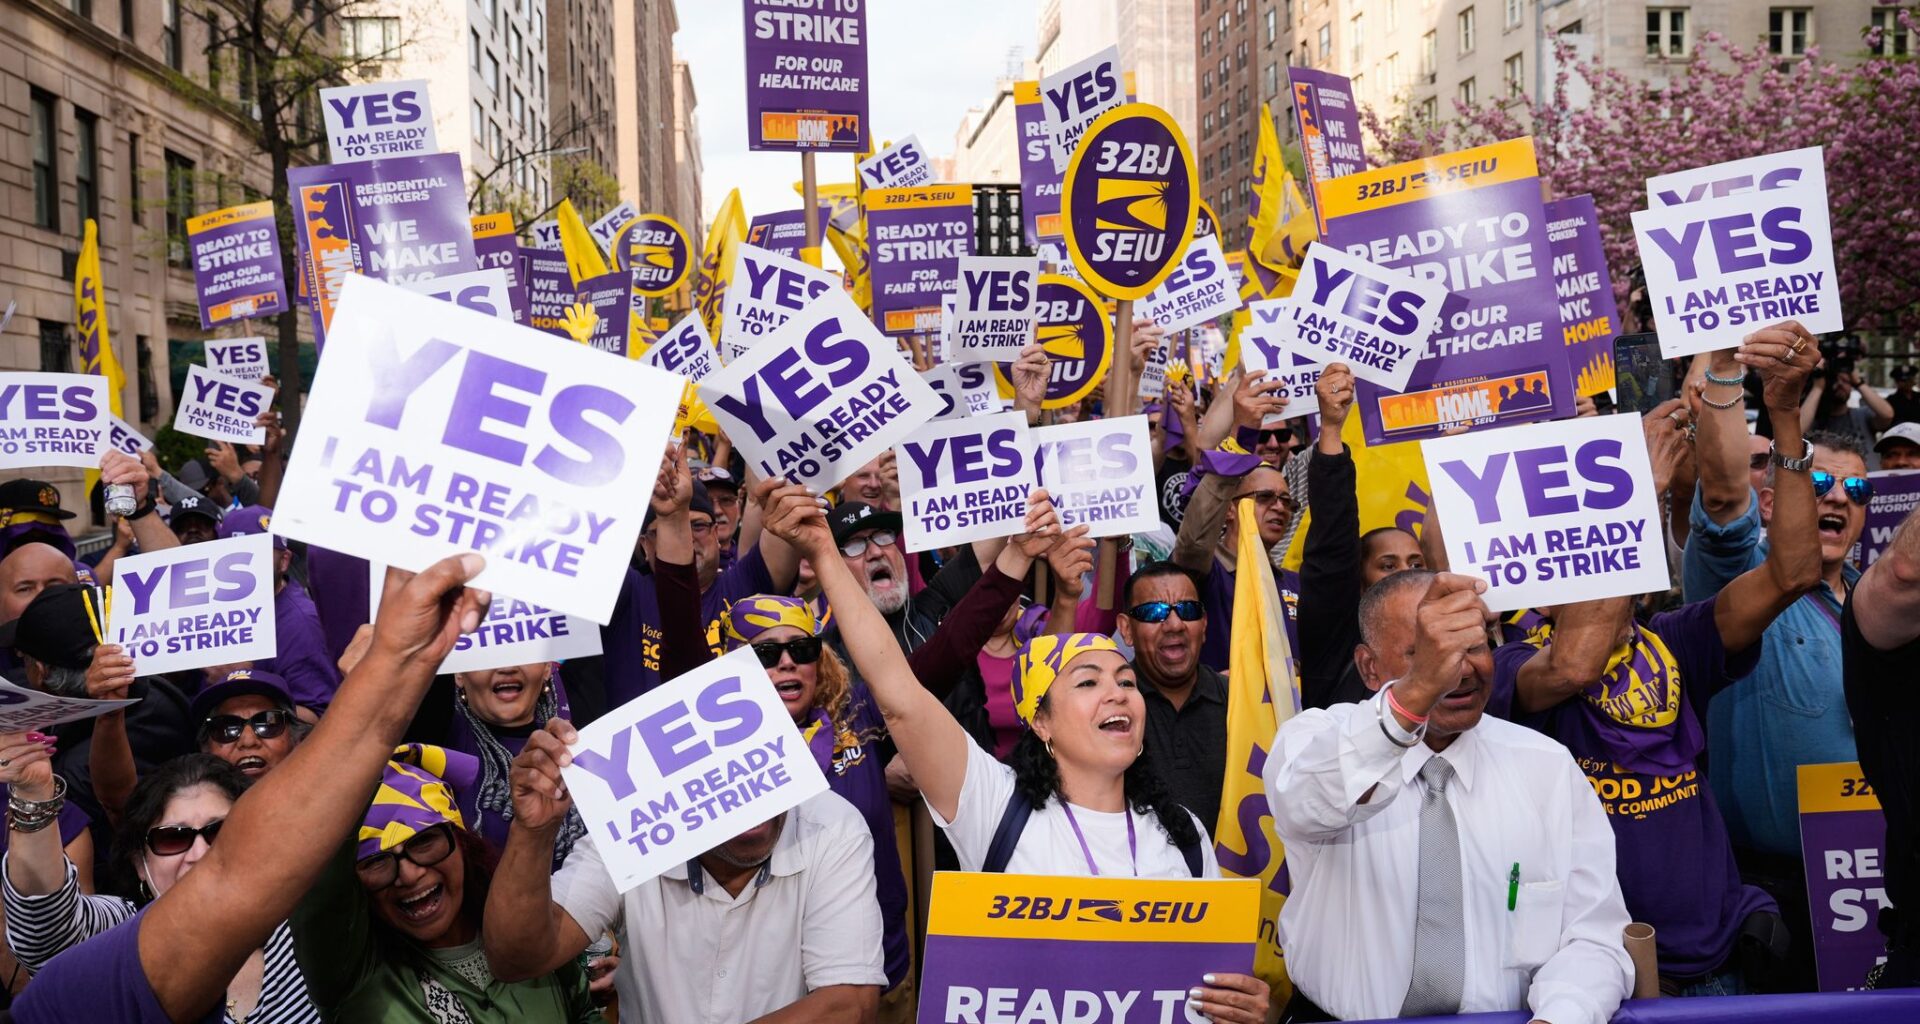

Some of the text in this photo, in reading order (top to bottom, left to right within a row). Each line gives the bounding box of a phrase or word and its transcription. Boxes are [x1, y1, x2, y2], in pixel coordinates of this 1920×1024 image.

[755, 11, 859, 45] STRIKE
[775, 56, 842, 73] FOR OUR
[759, 74, 859, 92] HEALTHCARE
[1047, 62, 1116, 123] YES
[328, 91, 422, 129] YES
[337, 128, 427, 146] I AM READY
[797, 120, 828, 141] HOME
[1057, 134, 1061, 145] I
[1064, 123, 1084, 142] AM
[1325, 120, 1346, 138] WE
[344, 140, 424, 158] TO STRIKE
[1096, 141, 1175, 175] 32BJ
[1329, 142, 1360, 161] MAKE
[865, 144, 920, 185] YES
[899, 164, 928, 186] READY
[356, 178, 446, 196] RESIDENTIAL
[1357, 157, 1497, 200] 32BJ SEIU
[356, 191, 430, 207] WORKERS
[885, 192, 954, 203] 32BJ SEIU
[364, 220, 419, 244] WE
[473, 222, 496, 232] SEIU
[595, 207, 635, 239] YES
[876, 222, 967, 240] READY TO
[196, 229, 270, 255] READY TO
[630, 229, 676, 245] 32BJ
[1092, 233, 1165, 263] SEIU
[1347, 212, 1529, 264] READY TO
[1645, 207, 1813, 282] YES
[199, 242, 273, 271] STRIKE
[353, 243, 362, 267] SEIU
[369, 242, 459, 271] MAKE
[489, 251, 512, 266] TO
[878, 239, 969, 263] STRIKE
[204, 272, 275, 296] HEALTHCARE
[213, 266, 261, 283] FOR OUR
[533, 279, 558, 290] WE
[631, 268, 673, 282] SEIU
[911, 270, 939, 281] FOR
[1556, 272, 1601, 299] MAKE
[532, 291, 574, 305] MAKE
[885, 283, 915, 294] FAIR
[964, 270, 1030, 311] YES
[1153, 279, 1225, 317] AM READY
[1312, 258, 1426, 336] YES
[1666, 272, 1824, 314] I AM READY
[531, 304, 561, 316] NYC
[736, 304, 774, 324] I AM
[1035, 300, 1084, 322] 2BJ
[1177, 292, 1225, 320] STRIKE
[1450, 305, 1507, 331] OUR
[1559, 298, 1591, 323] NYC
[1680, 294, 1819, 333] TO STRIKE
[741, 319, 763, 335] TO
[959, 319, 1030, 332] I AM READY
[1293, 307, 1301, 320] I
[1304, 313, 1337, 334] AM
[1340, 326, 1411, 360] READY
[1563, 316, 1612, 346] HOME
[962, 334, 1025, 348] TO STRIKE
[1298, 325, 1396, 373] TO STRIKE
[1422, 322, 1543, 359] LTHCARE
[210, 344, 261, 365] YES
[236, 365, 264, 373] READY
[715, 317, 870, 444] YES
[1445, 376, 1488, 387] RESIDENTIAL
[194, 374, 262, 417] YES
[362, 327, 636, 487] YES
[1436, 389, 1493, 423] HOME
[189, 416, 253, 437] TO STRIKE
[193, 408, 213, 419] AM
[216, 414, 256, 430] READY
[761, 460, 776, 477] I
[776, 432, 817, 471] AM
[814, 368, 900, 440] READY
[1475, 416, 1496, 425] SEIU
[0, 428, 101, 442] AM READY
[25, 441, 95, 455] STRIKE
[784, 459, 820, 485] TO
[820, 392, 912, 463] STRIKE
[903, 429, 1023, 489] YES
[320, 436, 615, 545] I AM READY
[1438, 439, 1634, 524] YES
[913, 483, 1030, 516] I AM READY
[1071, 485, 1144, 506] READY
[1870, 493, 1920, 505] RESIDEN
[921, 502, 1025, 533] TO STRIKE
[1063, 503, 1139, 524] STRIKE
[332, 479, 584, 577] TO STRIKE
[1464, 519, 1646, 564] I AM READY
[1482, 546, 1641, 587] TO STRIKE
[121, 552, 256, 616] YES
[119, 607, 262, 642] I AM READY
[455, 615, 569, 650] STRIKE
[642, 623, 663, 639] Vote
[126, 627, 253, 658] TO STRIKE
[572, 676, 763, 802] YES
[834, 745, 861, 772] SIU
[606, 735, 786, 842] I AM READY
[1619, 783, 1699, 815] COMMUNIT
[628, 763, 792, 856] TO STRIKE
[987, 895, 1209, 924] 32BJ SEIU
[944, 985, 1141, 1024] READY
